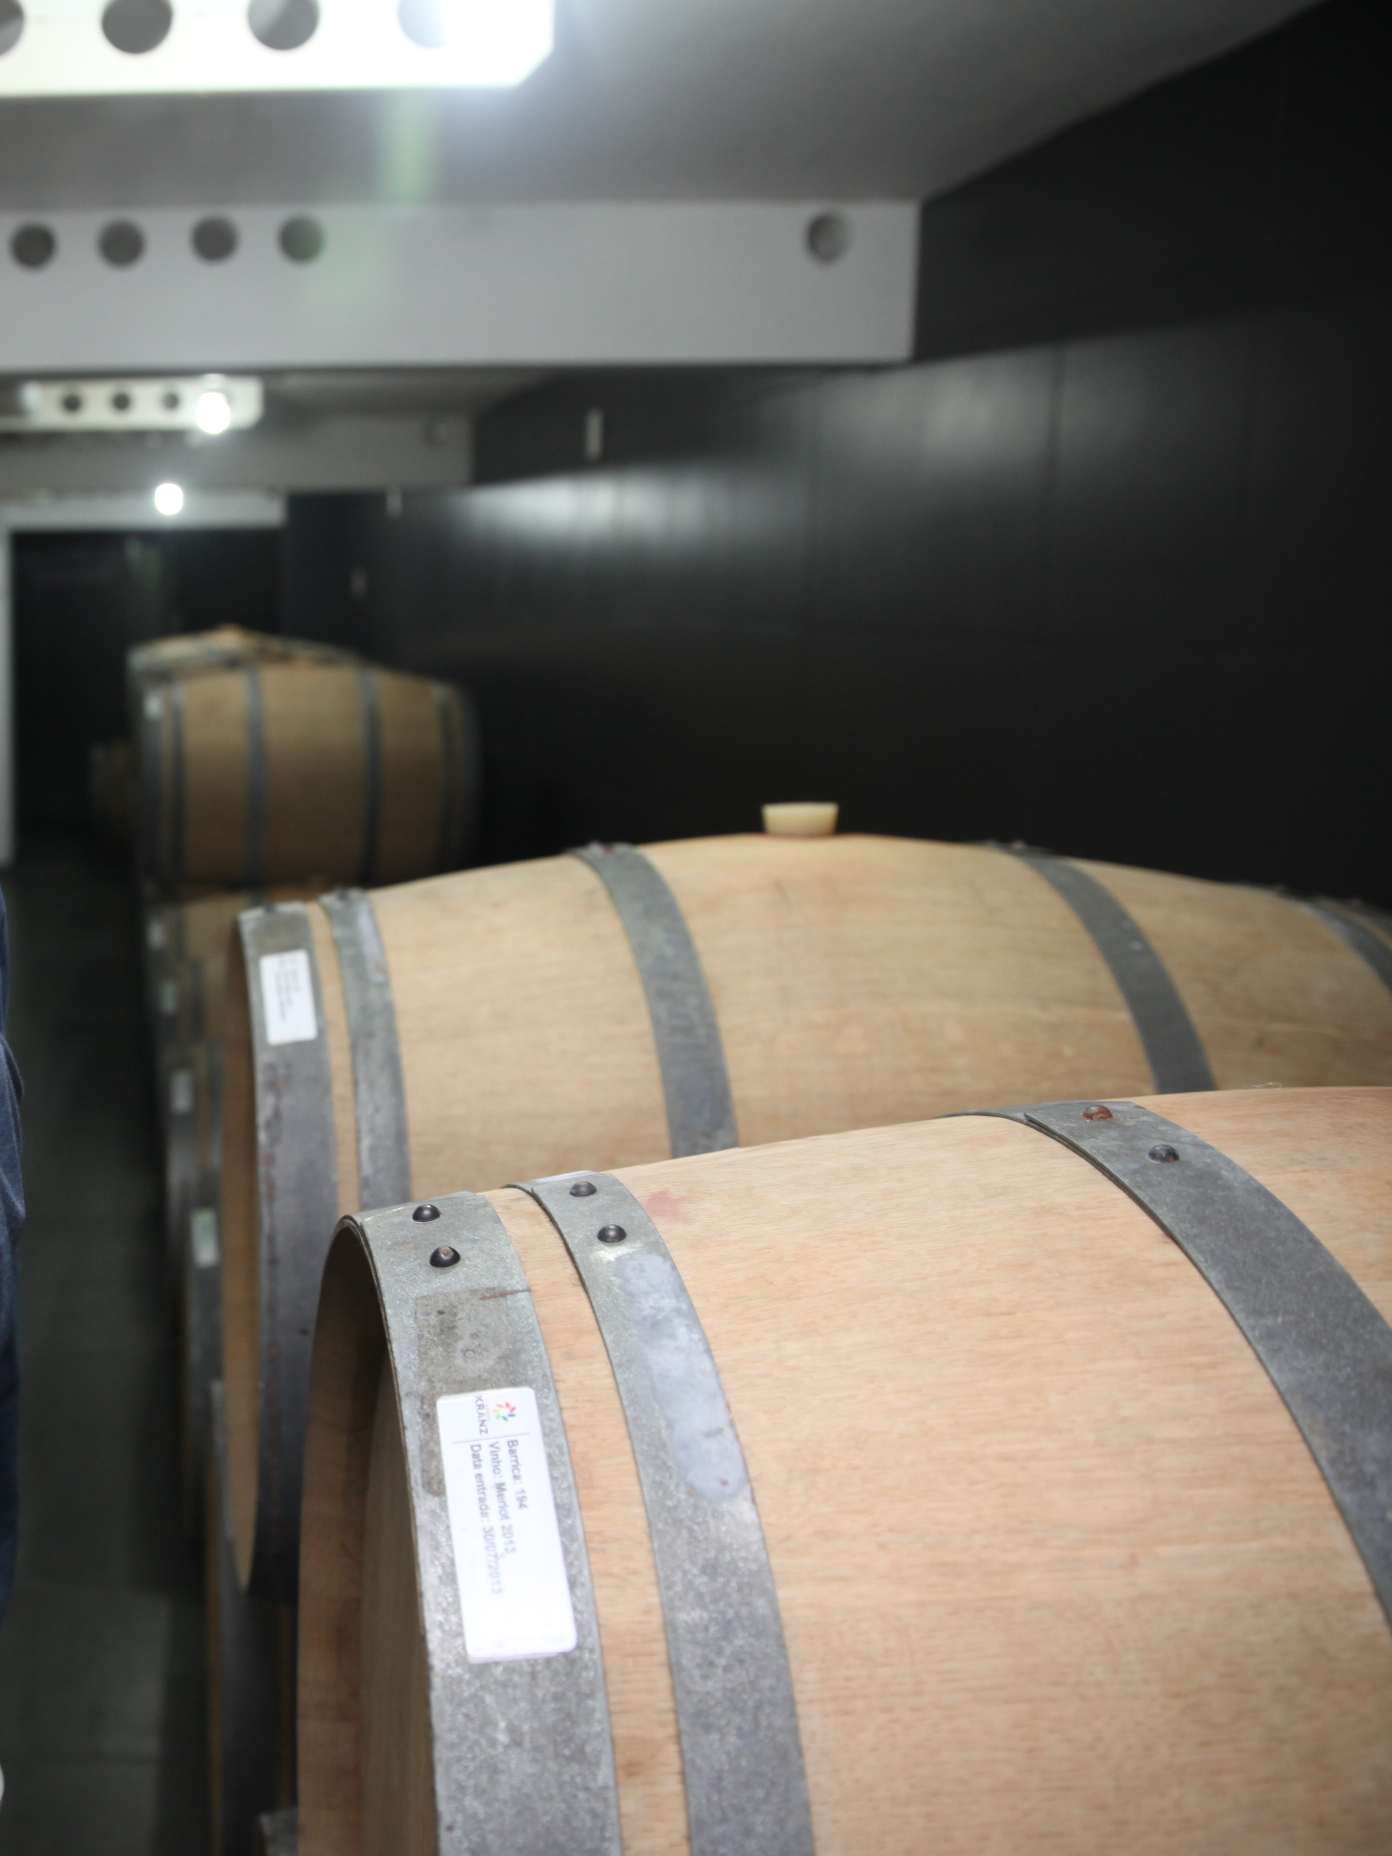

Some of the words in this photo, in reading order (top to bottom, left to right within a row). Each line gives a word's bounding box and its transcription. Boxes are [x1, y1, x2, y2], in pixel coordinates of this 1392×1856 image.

[475, 1394, 489, 1436] KRANZ
[470, 1444, 483, 1470] Data
[489, 1441, 503, 1479] Vinho:
[507, 1439, 522, 1485] Barrica:
[515, 1489, 528, 1510] 194
[474, 1473, 490, 1522] entrada:
[494, 1482, 510, 1521] Merlot
[501, 1524, 517, 1554] 2013
